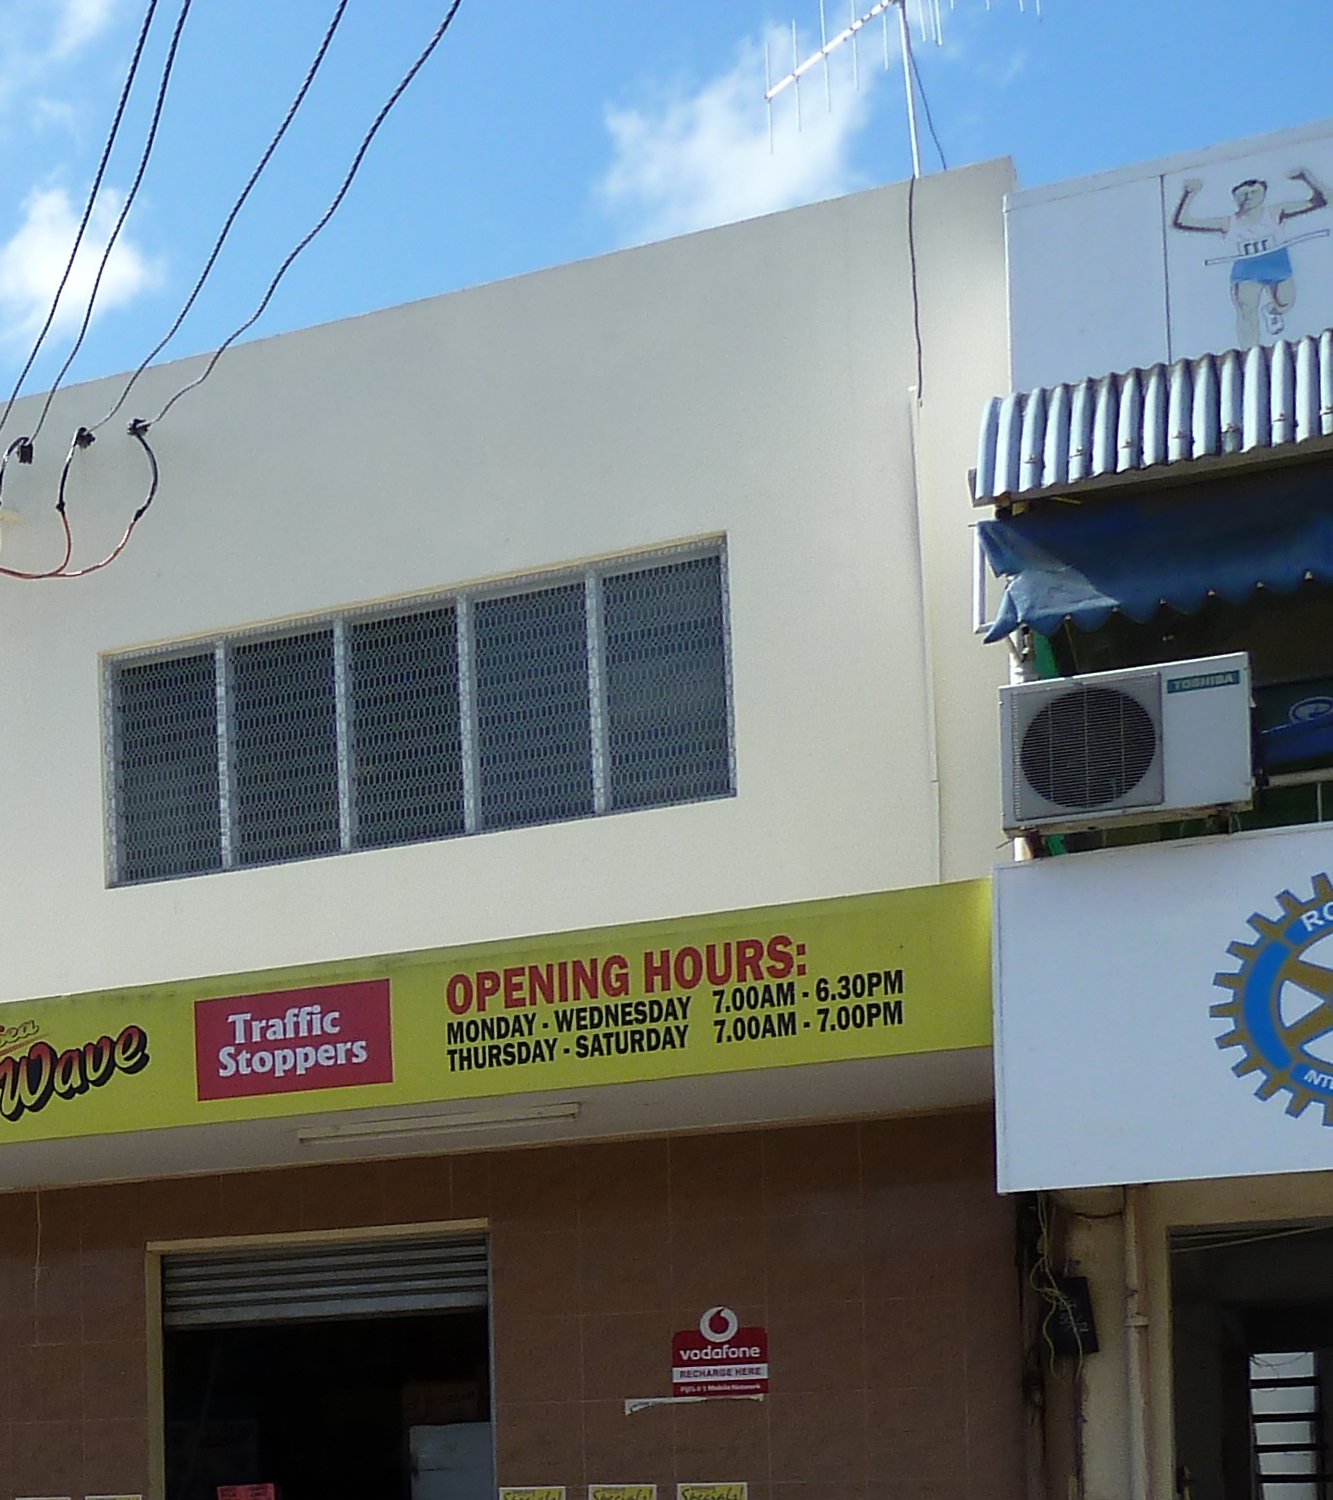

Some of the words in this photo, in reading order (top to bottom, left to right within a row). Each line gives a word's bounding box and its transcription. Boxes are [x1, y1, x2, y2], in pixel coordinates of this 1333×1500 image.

[1173, 673, 1233, 690] TOSHIBA
[446, 953, 629, 1015] OPENING
[644, 934, 808, 994] HOURS:
[227, 1004, 341, 1045] Traffic
[446, 1012, 536, 1045] MONDAY
[555, 996, 692, 1032] WEDNESDAY
[712, 982, 796, 1014] 7.00AM
[815, 969, 904, 1001] 6.30PM
[446, 1038, 558, 1072] THURSDAY
[575, 1025, 689, 1060] SATURDAY
[713, 1011, 797, 1044] 7.00AM
[817, 1001, 904, 1033] 7.00PM
[218, 1037, 368, 1077] Stoppers
[679, 1344, 762, 1361] vodafone
[679, 1368, 733, 1379] RECHARGE
[735, 1366, 762, 1377] HERE
